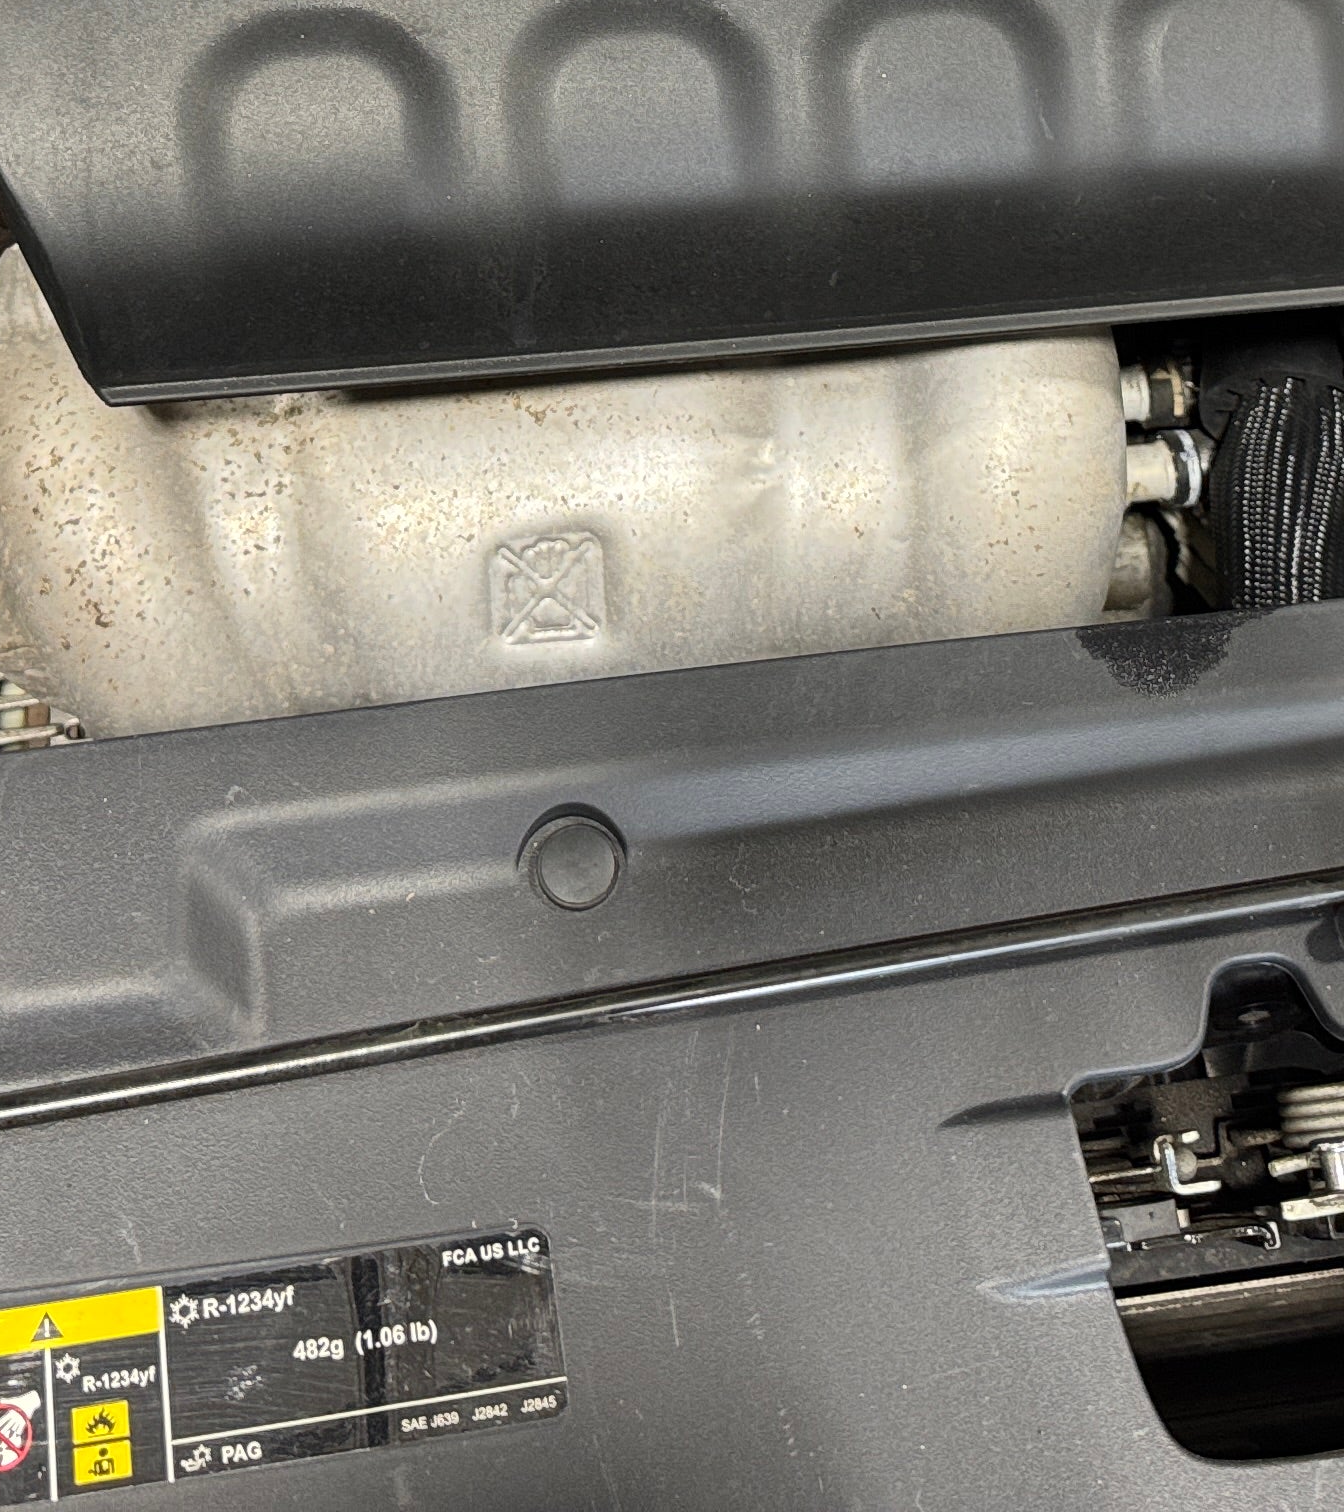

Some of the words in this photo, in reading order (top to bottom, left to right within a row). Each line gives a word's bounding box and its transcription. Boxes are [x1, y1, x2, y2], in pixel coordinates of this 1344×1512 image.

[442, 1250, 477, 1268] FCA
[479, 1244, 503, 1261] US
[507, 1237, 541, 1257] LLC
[202, 1285, 295, 1319] R-1234yf
[292, 1336, 344, 1361] 482g
[355, 1330, 406, 1356] (1.06
[409, 1319, 439, 1345] lb)
[82, 1365, 156, 1393] R-1234yf
[401, 1415, 428, 1433] SAE
[430, 1411, 460, 1429] J639
[472, 1403, 509, 1422] J2842
[520, 1394, 558, 1414] J2845
[221, 1441, 262, 1465] PAG
